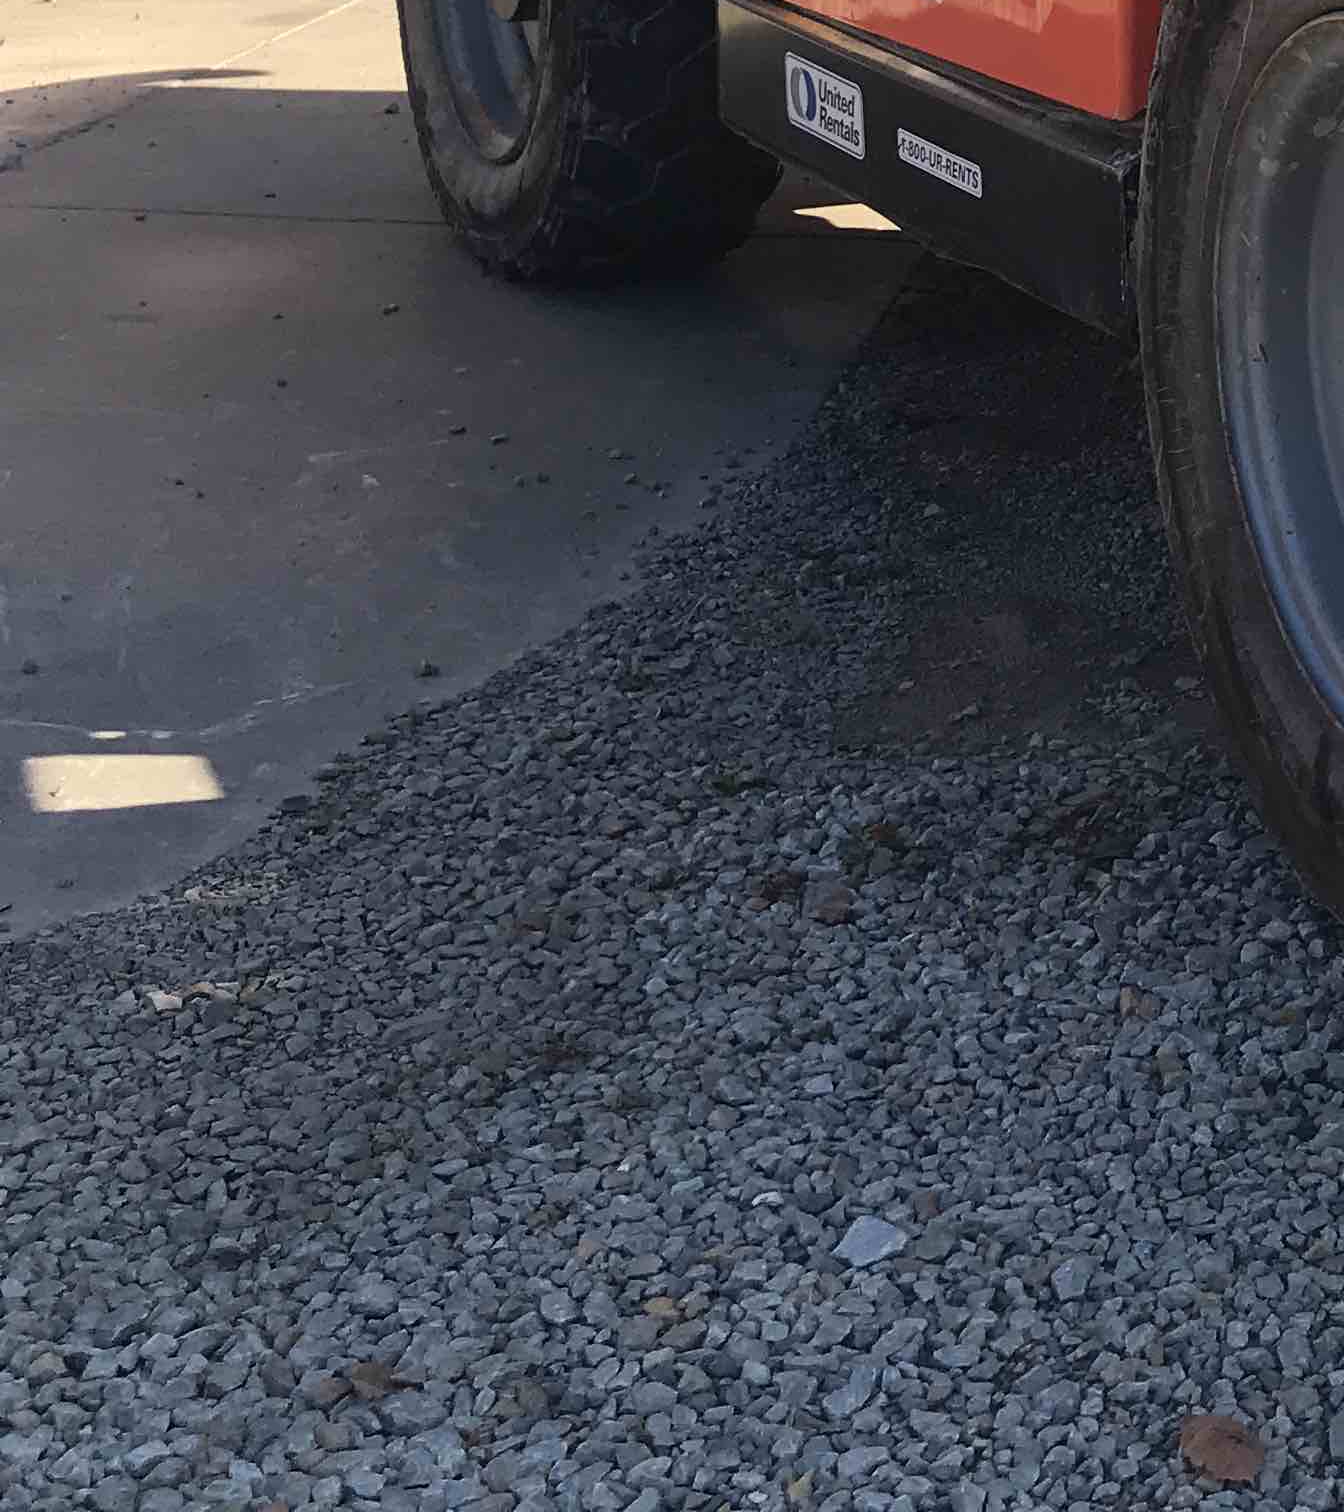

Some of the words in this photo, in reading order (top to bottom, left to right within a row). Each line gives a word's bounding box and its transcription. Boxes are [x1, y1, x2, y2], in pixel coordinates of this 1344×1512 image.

[818, 79, 855, 119] United
[819, 106, 861, 147] Rentals
[901, 137, 980, 190] 1-800-UR-RENTS
